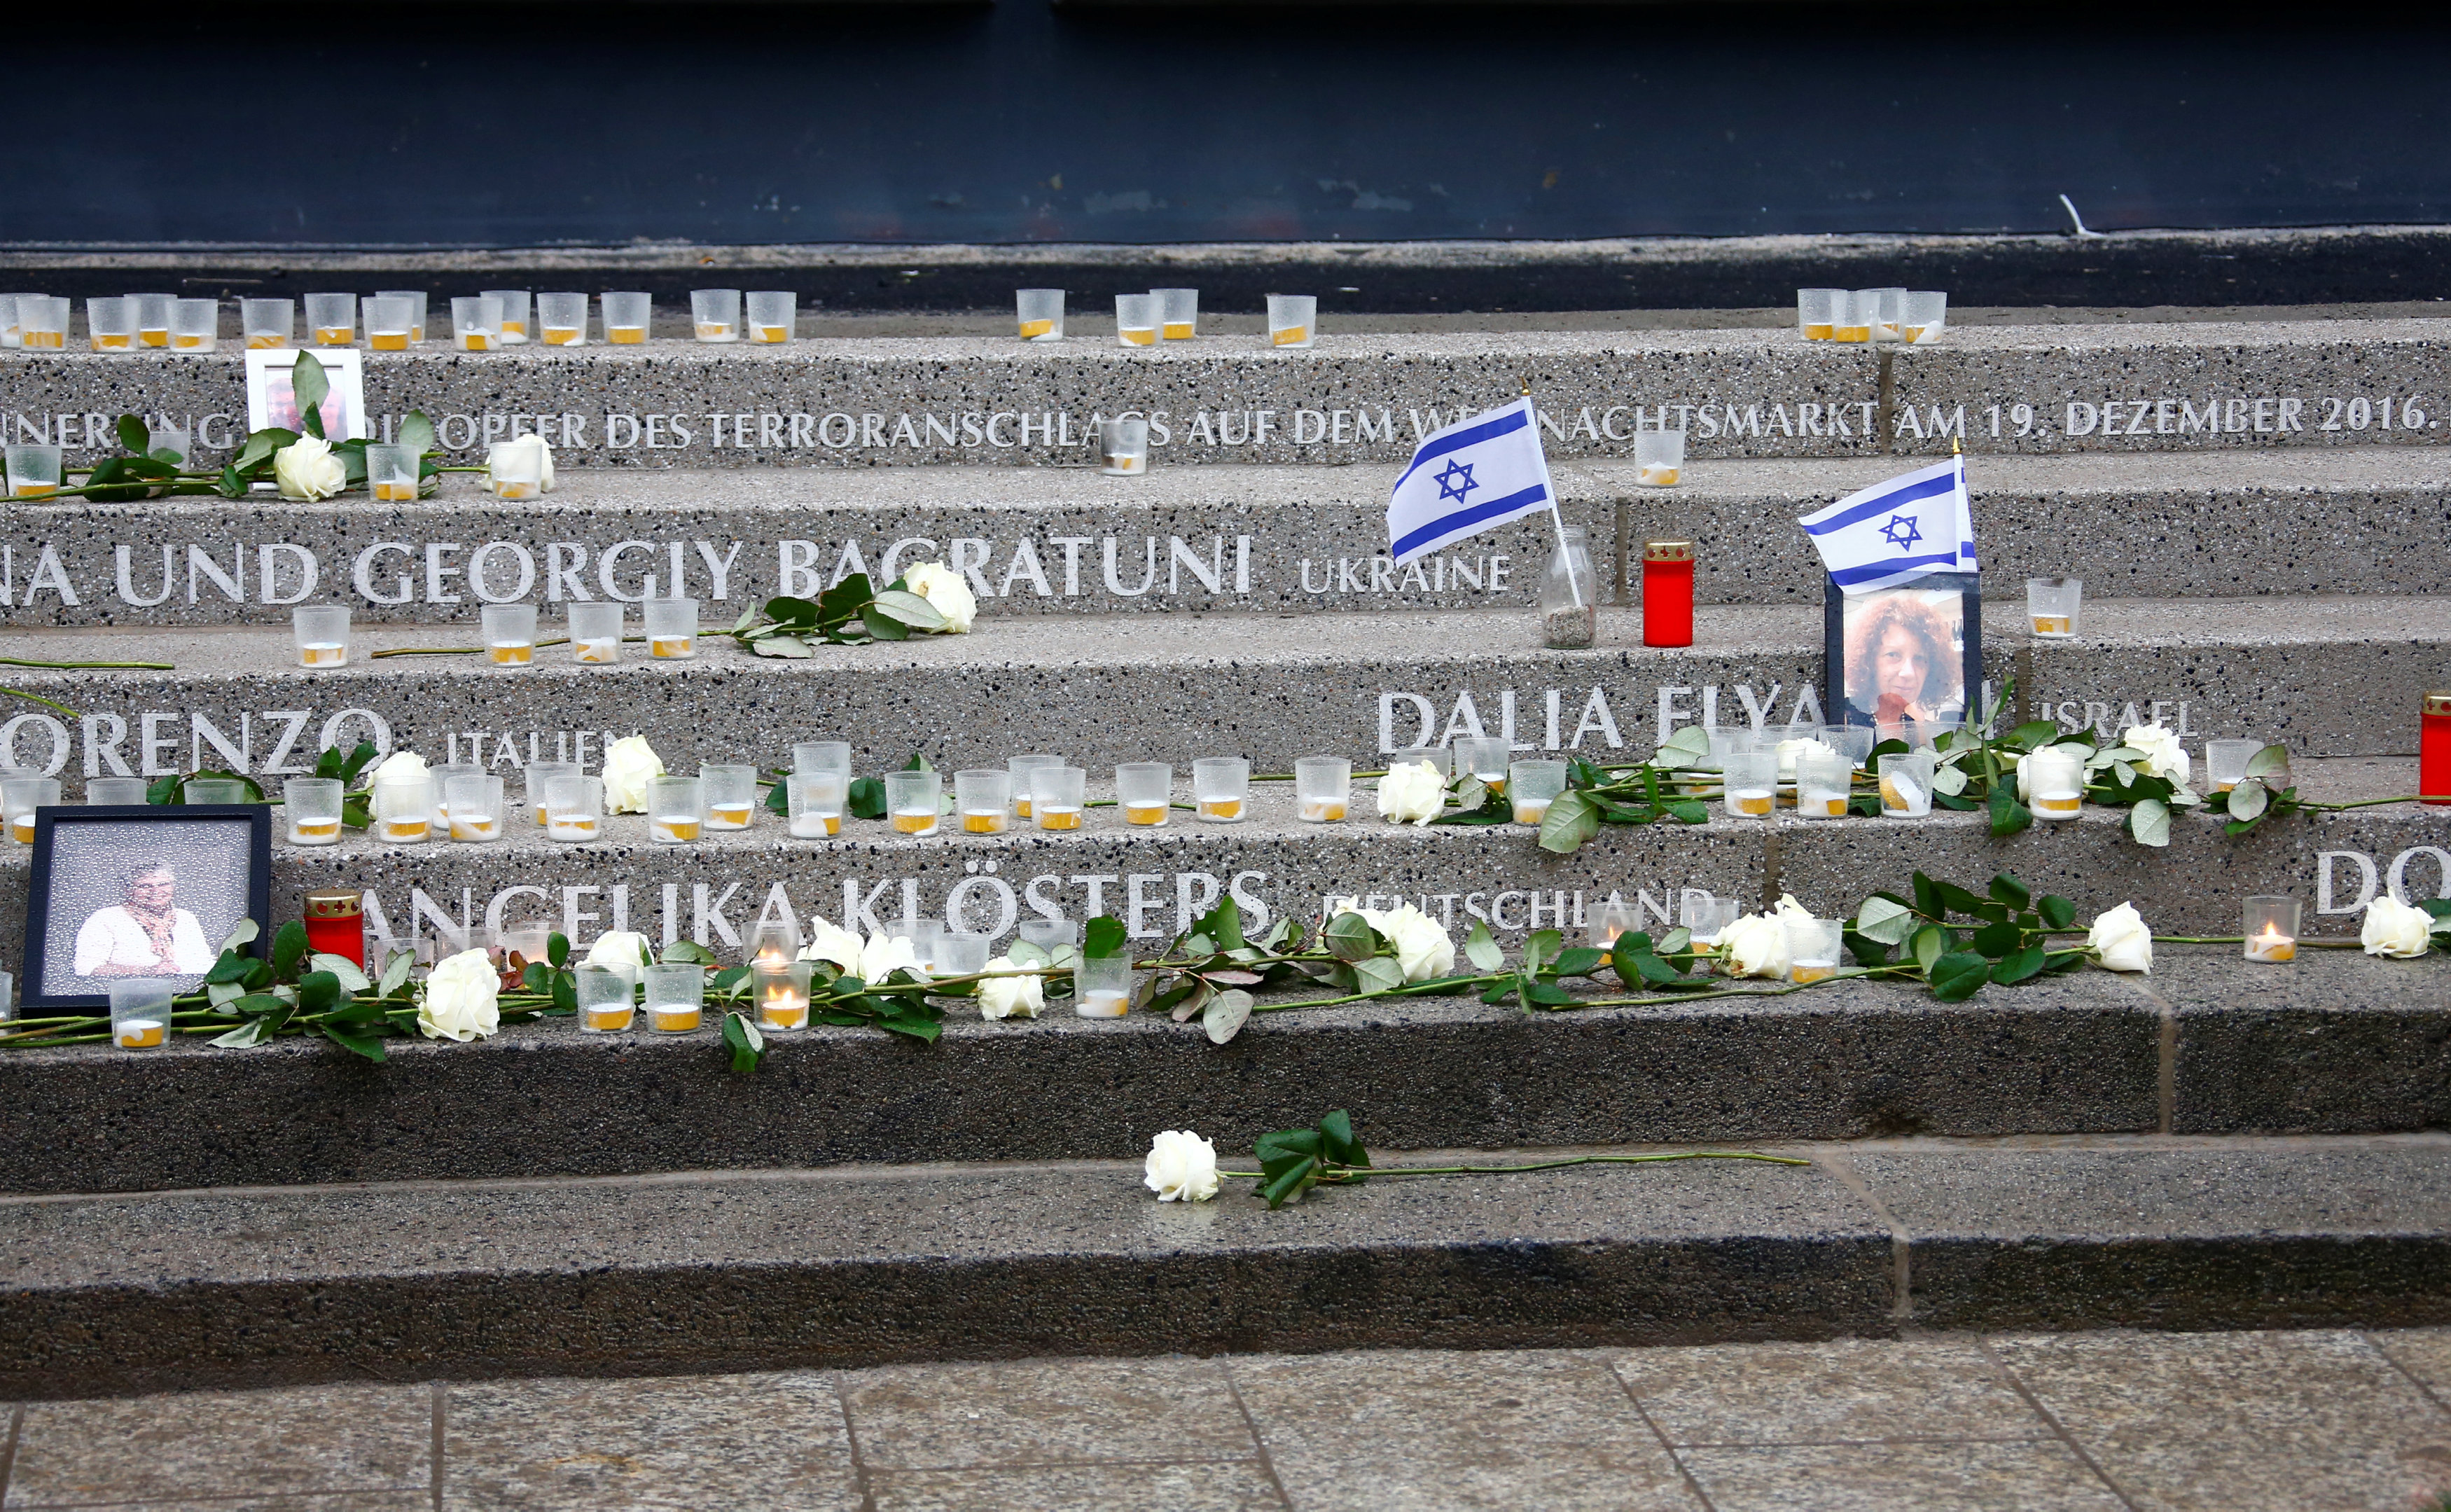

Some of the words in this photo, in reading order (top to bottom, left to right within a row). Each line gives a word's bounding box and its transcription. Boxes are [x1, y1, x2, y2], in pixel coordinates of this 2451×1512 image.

[0, 412, 235, 450] NERNG
[438, 413, 588, 450] OPFER
[606, 413, 693, 450] DES
[1187, 410, 1276, 447] AUF
[1294, 409, 1394, 445] DEM
[1408, 401, 1880, 443] WNACHTSMARKT
[1895, 404, 1965, 439] AM
[1983, 403, 2046, 438] 19.
[2066, 398, 2304, 436] DEZEMBER
[2320, 395, 2437, 431] 2016.
[0, 543, 81, 607] A
[116, 542, 319, 607] UND
[352, 540, 743, 604] GEORGIY
[779, 535, 1251, 599] BAGRATUNI
[1300, 555, 1510, 595] UKRAINE
[0, 708, 392, 777] ORENZO
[447, 730, 638, 770] ITALIE
[1377, 686, 1624, 755] DALIA
[2041, 700, 2199, 739] ISRAEL
[361, 881, 807, 951] ANGELIKA
[842, 860, 1272, 941] KLÖSTERS
